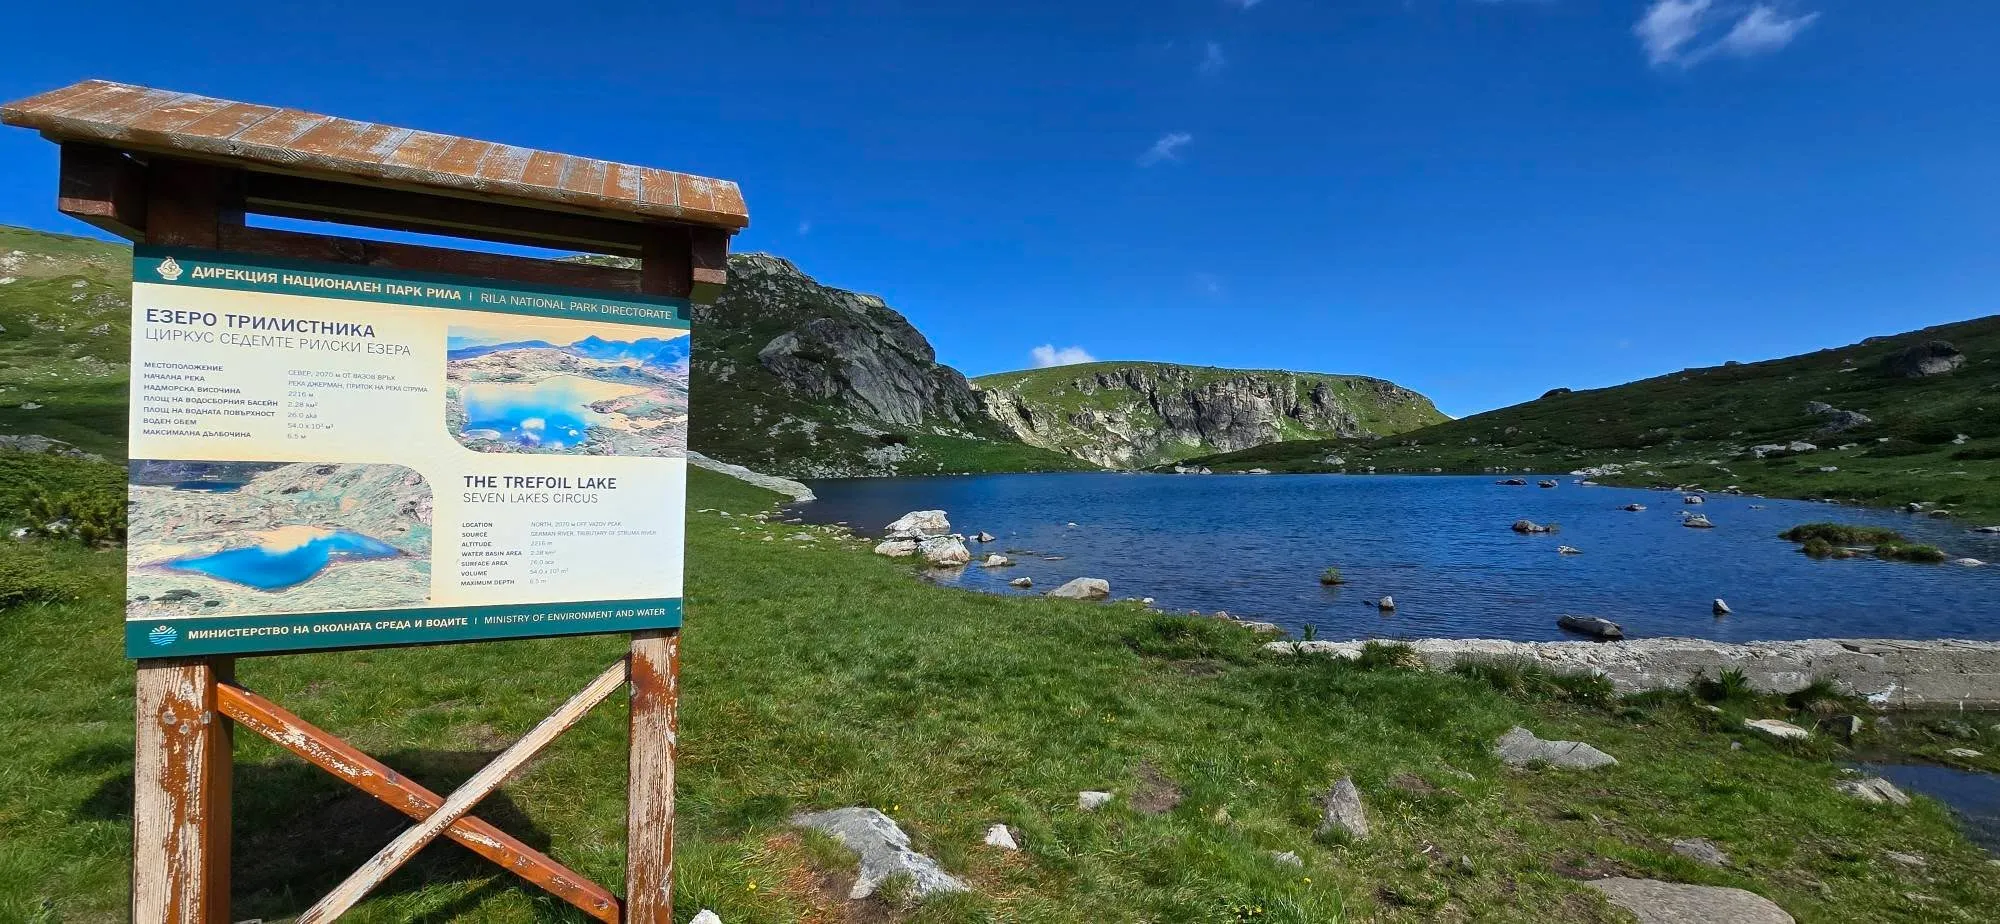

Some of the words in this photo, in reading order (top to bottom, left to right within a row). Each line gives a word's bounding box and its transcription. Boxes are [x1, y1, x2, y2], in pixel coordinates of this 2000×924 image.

[192, 266, 278, 284] ДИРЕКЦИЯ
[283, 274, 382, 292] НАЦИОНАЛЕН
[386, 284, 422, 297] ПАРК
[427, 288, 461, 300] РИЛА
[481, 293, 506, 304] RILA
[510, 296, 566, 310] NATIONAL
[570, 302, 598, 312] PARK
[602, 304, 672, 320] DIRECTORATE
[146, 308, 217, 326] ЕЗЕРО
[225, 314, 376, 338] ТРИЛИСТНИКА
[146, 328, 214, 344] ЦИРКУС
[220, 332, 294, 348] СЕДЕМТЕ
[300, 339, 361, 353] РИЛСКИ
[368, 343, 410, 356] ЕЗЕРА
[144, 362, 224, 372] МЕСТОПОЛОЖЕНИЕ
[186, 397, 245, 405] ВОДОСБОРНИЯ
[464, 476, 497, 488] THE
[503, 476, 572, 489] TREFOIL
[577, 478, 617, 489] LAKE
[463, 493, 505, 503] SEVEN
[510, 493, 548, 503] LAKES
[553, 493, 598, 503] CIRCUS
[484, 614, 530, 624] MINISTRY
[548, 611, 613, 621] ENVIRONMENT
[616, 609, 634, 617] AND
[637, 608, 665, 616] WATER
[188, 626, 289, 640] МИНИСТЕРСТВО
[293, 624, 309, 634] НА
[313, 622, 372, 633] ОКОЛНАТА
[376, 620, 411, 630] СРЕДА
[426, 617, 468, 628] ВОДИТЕ
